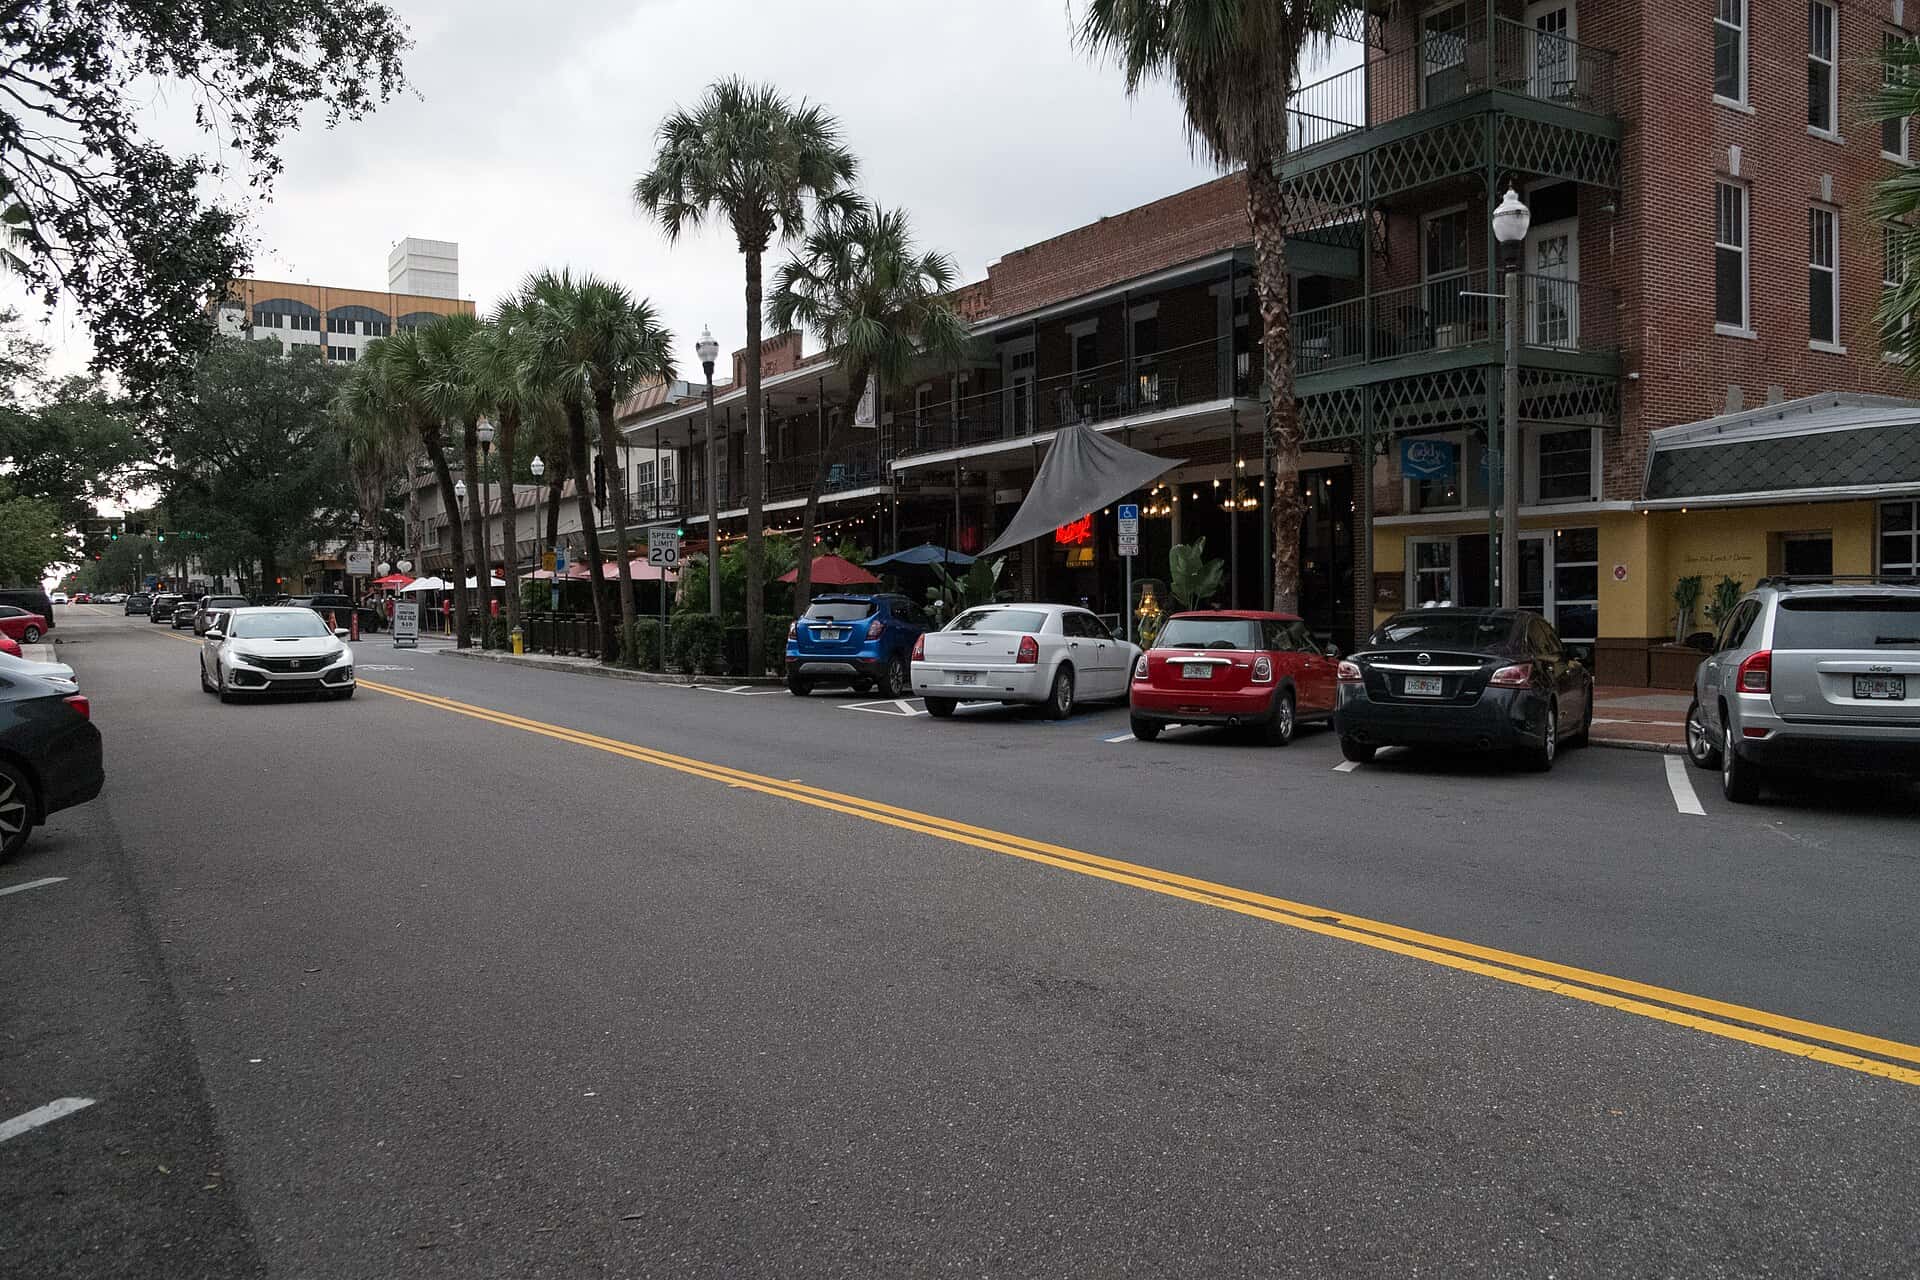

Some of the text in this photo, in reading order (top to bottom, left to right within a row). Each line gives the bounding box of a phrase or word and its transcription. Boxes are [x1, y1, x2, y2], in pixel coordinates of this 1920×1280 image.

[651, 532, 676, 540] SPEED
[651, 548, 676, 562] 20
[1869, 664, 1893, 672] Jeep
